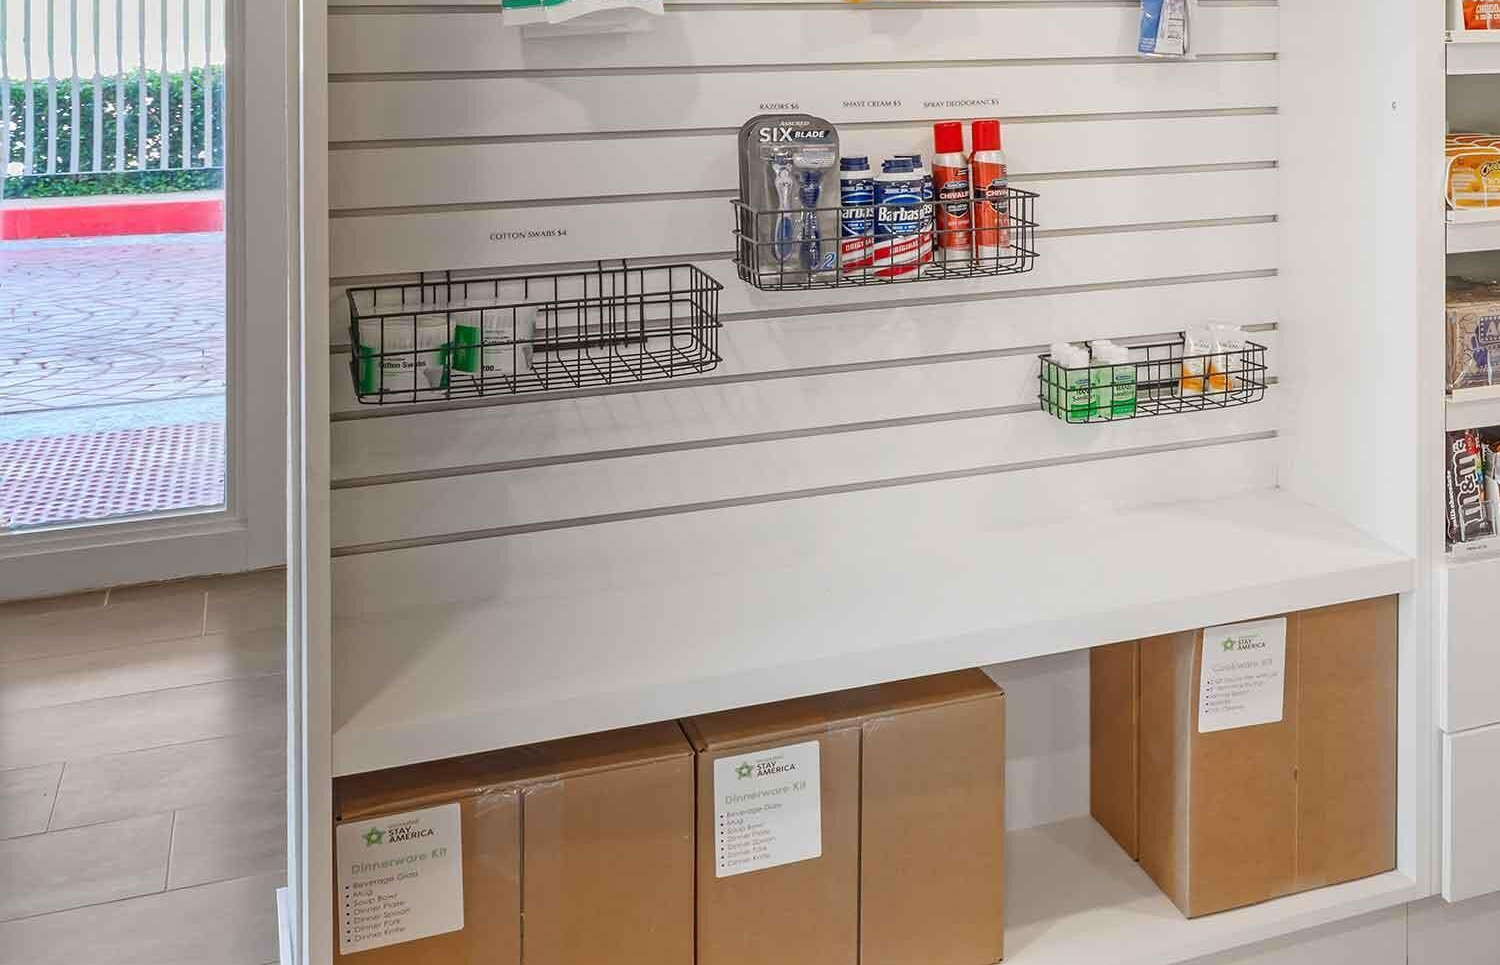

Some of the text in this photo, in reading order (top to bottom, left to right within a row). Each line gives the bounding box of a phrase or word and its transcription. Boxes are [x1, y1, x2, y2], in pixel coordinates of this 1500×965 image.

[760, 102, 790, 110] RAZORS
[946, 100, 990, 108] DEODORANT
[760, 127, 825, 142] SIX BLADE
[490, 231, 526, 240] COTTON
[823, 252, 836, 270] 2
[756, 762, 777, 770] STAY
[756, 764, 796, 776] AMERICA
[726, 786, 790, 804] Dinnerware
[388, 826, 412, 836] STAY
[388, 828, 434, 844] AMERICA
[352, 848, 448, 875] Dinnerware Kit
